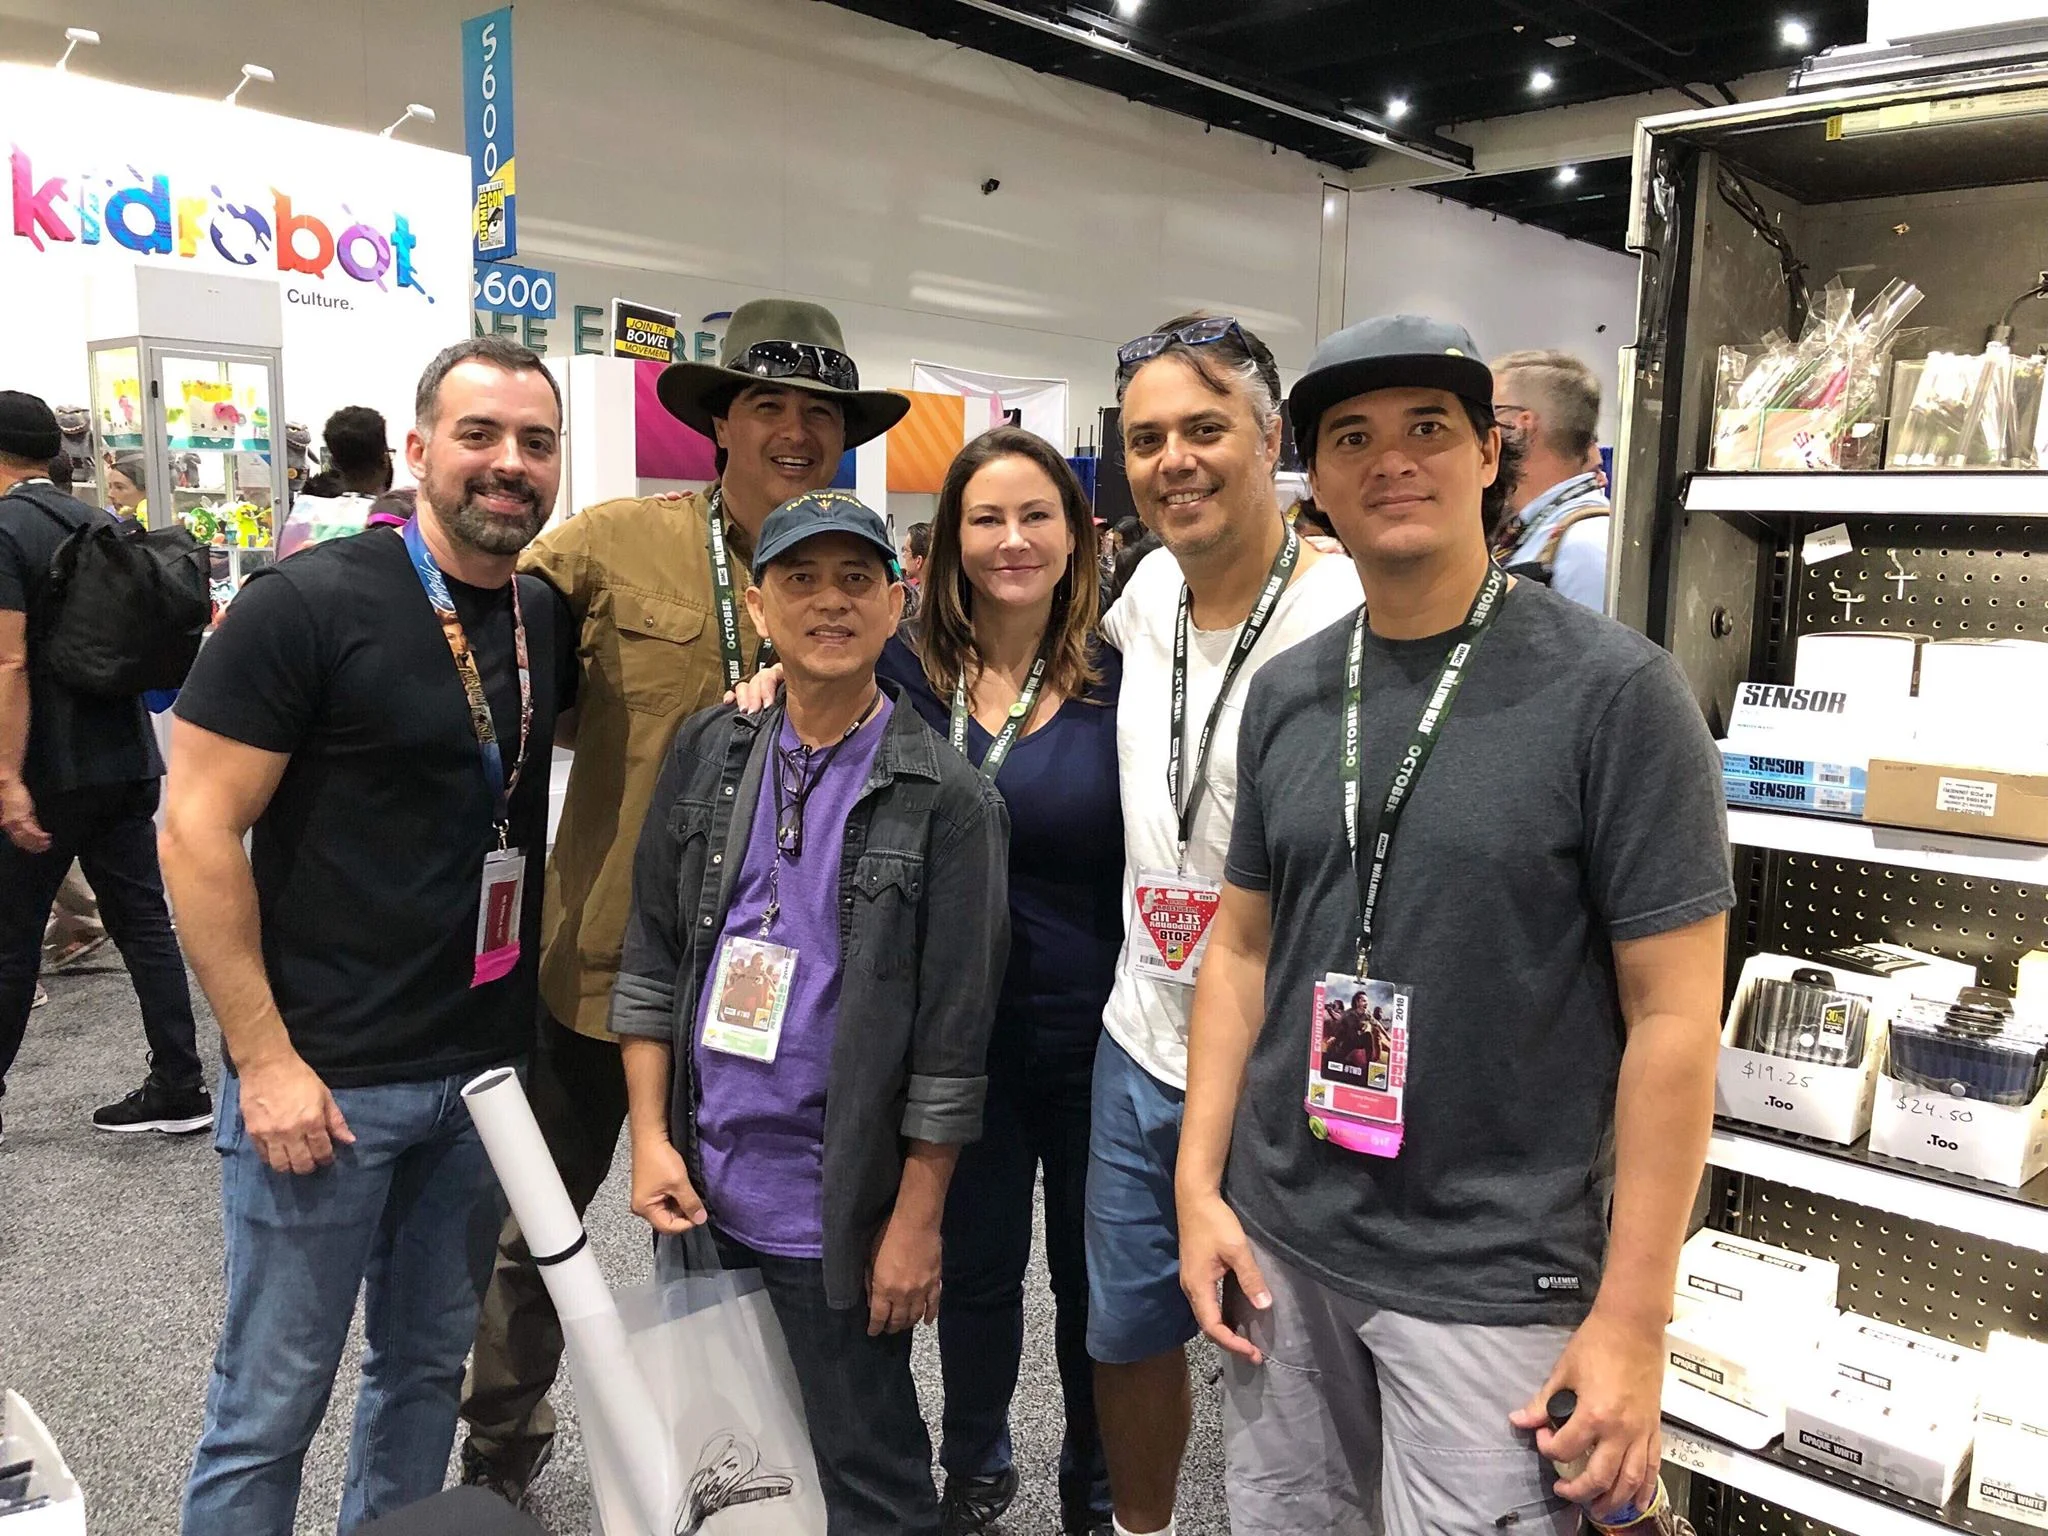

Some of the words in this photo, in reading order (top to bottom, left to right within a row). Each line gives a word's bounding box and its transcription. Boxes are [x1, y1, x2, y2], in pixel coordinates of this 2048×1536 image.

[482, 22, 498, 177] 5600
[488, 188, 503, 208] CON
[9, 143, 426, 298] kidrobot
[480, 193, 489, 240] COMIC
[287, 288, 355, 311] Culture.
[627, 329, 668, 349] BOWEL
[630, 320, 653, 331] JOIN
[655, 325, 669, 335] THE
[625, 343, 668, 358] MOVEMENT
[1250, 597, 1274, 628] WALKING
[1265, 575, 1283, 597] DEAD
[1468, 570, 1502, 627] OCTOBER
[722, 598, 737, 649] OCTOBER
[1173, 668, 1183, 723] OCTOBER
[1428, 670, 1459, 709] WALKING
[1742, 684, 1848, 714] SENSOR
[988, 723, 1016, 763] OCTOBER
[1346, 701, 1358, 768] OCTOBER
[1384, 745, 1422, 813] OCTOBER
[1749, 756, 1805, 776] SENSOR
[1749, 781, 1806, 801] SENSOR
[1367, 863, 1382, 907] WALKING
[1150, 911, 1201, 925] SET-UP
[1150, 921, 1202, 932] TEMPORARY
[1363, 907, 1372, 933] DEAD
[1160, 930, 1191, 942] 2018
[1313, 993, 1324, 1052] EXHIBITOR
[1395, 997, 1405, 1020] 2018
[1742, 1060, 1815, 1089] $19.25
[1764, 1095, 1794, 1112] .Too
[1896, 1096, 1974, 1123] $24.50
[1926, 1134, 1959, 1151] .Too
[1673, 1355, 1698, 1373] OPAQUE
[1699, 1366, 1721, 1383] WHITE
[1802, 1433, 1832, 1453] OPAQUE
[1833, 1445, 1860, 1463] WHITE
[1982, 1485, 2016, 1503] OPAQUE
[2017, 1495, 2045, 1511] WHITE
